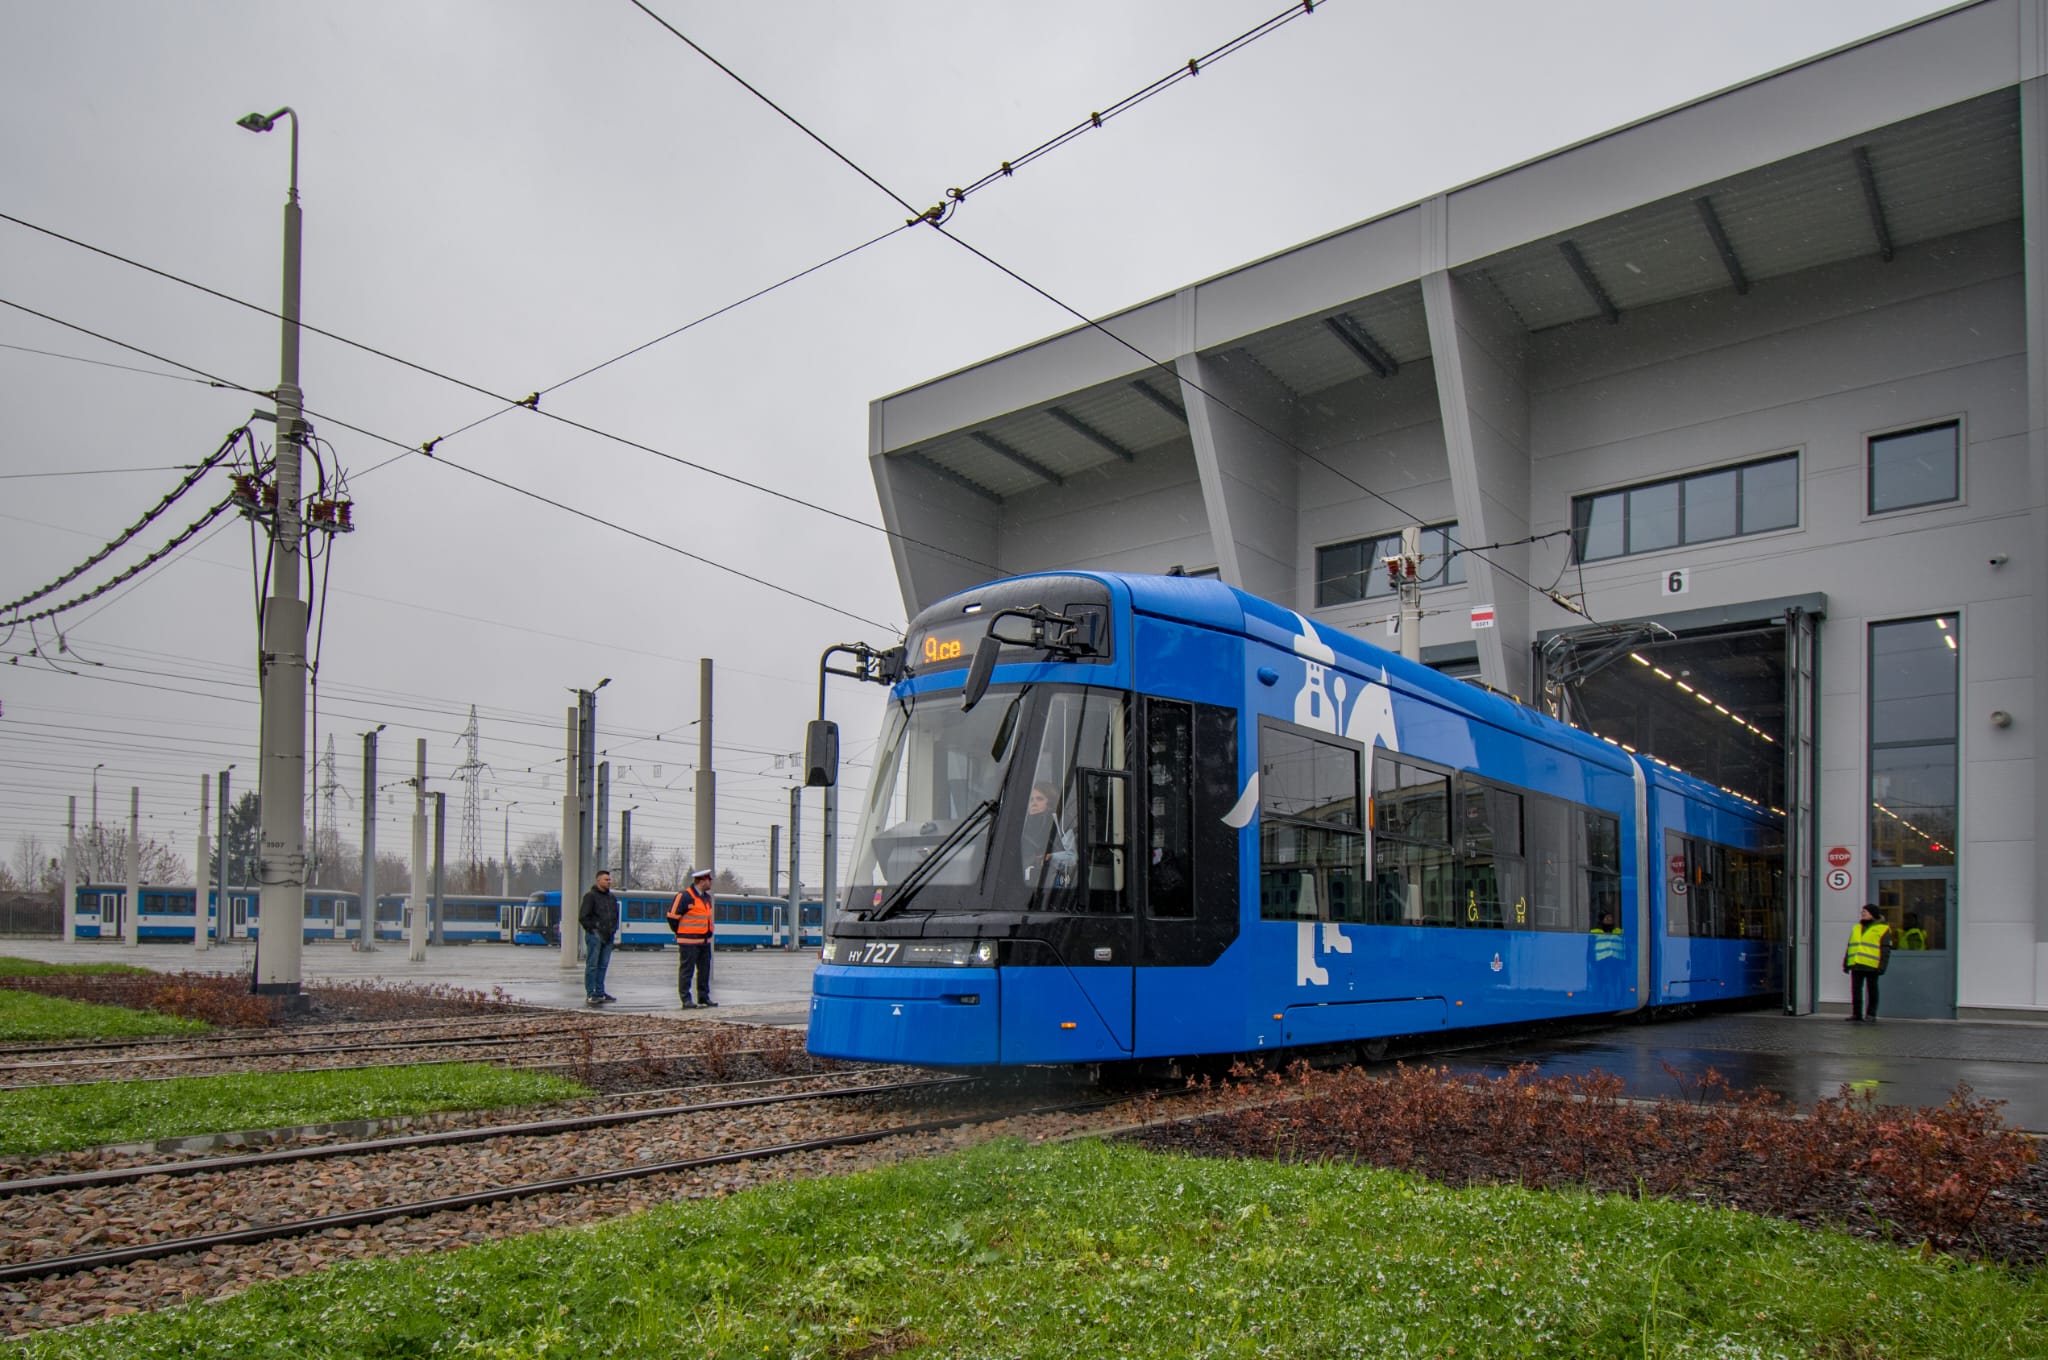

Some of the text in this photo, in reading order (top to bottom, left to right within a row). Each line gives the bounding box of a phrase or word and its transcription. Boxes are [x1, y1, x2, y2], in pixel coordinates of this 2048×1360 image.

[1669, 571, 1682, 593] 6
[1392, 615, 1400, 634] 7
[1833, 873, 1845, 886] 5
[848, 943, 900, 964] HY 727
